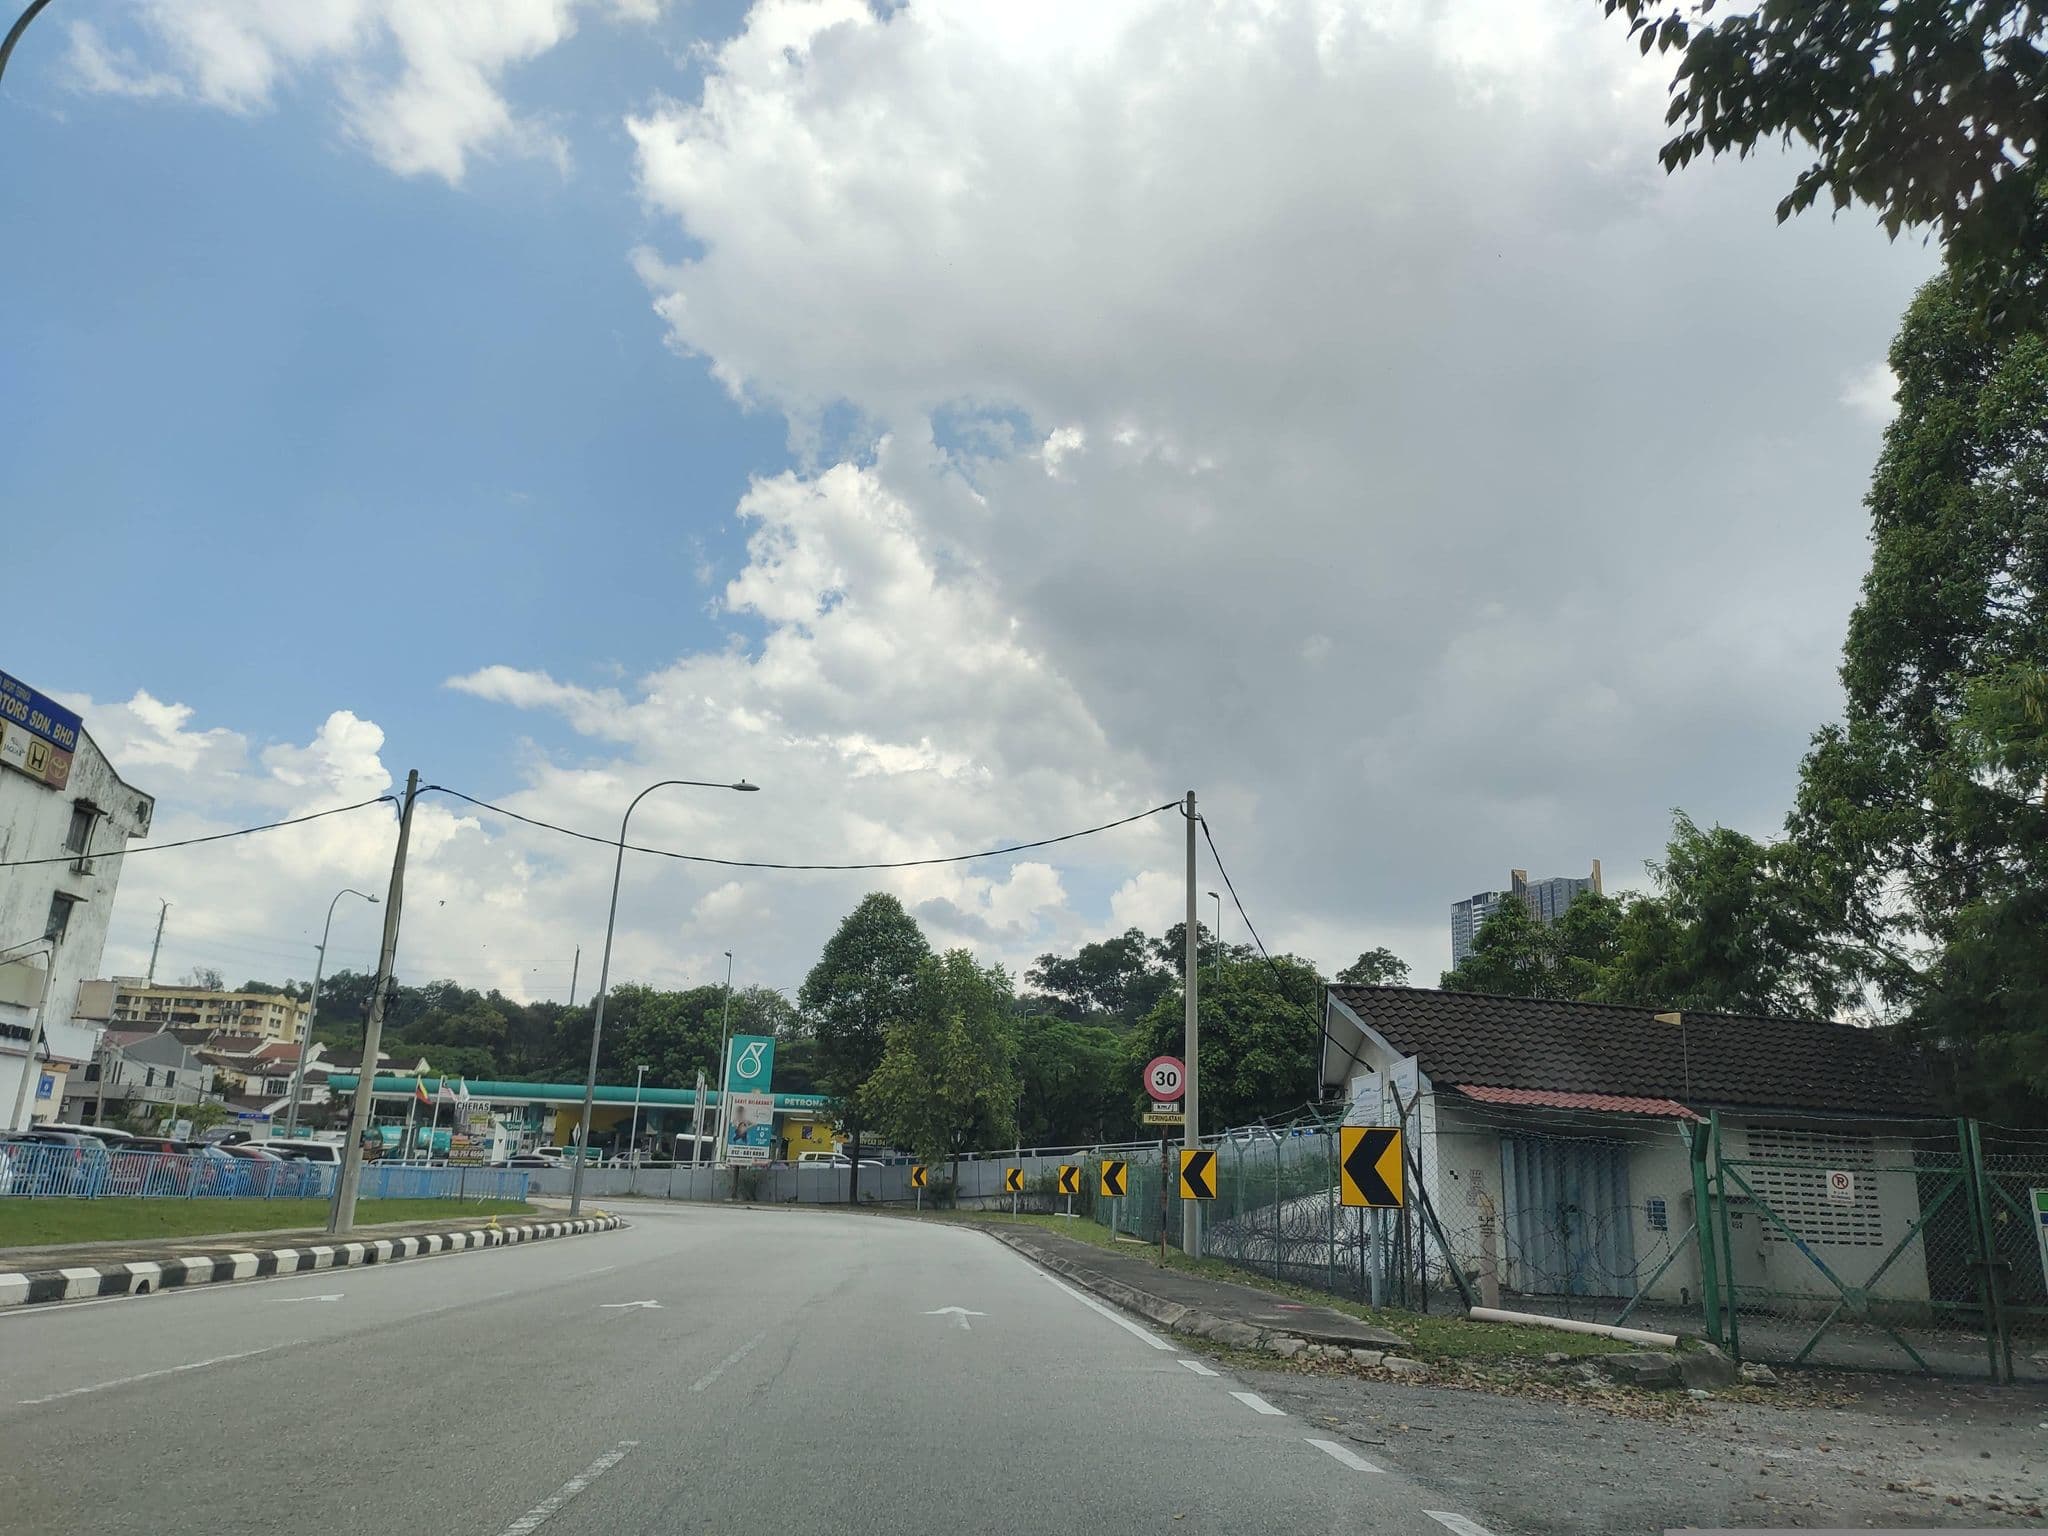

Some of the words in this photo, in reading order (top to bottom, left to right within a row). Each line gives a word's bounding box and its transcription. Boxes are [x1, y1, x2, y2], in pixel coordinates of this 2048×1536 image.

[0, 688, 29, 723] TORS
[29, 709, 51, 735] SDN.
[53, 723, 75, 748] BHD.
[1155, 1071, 1177, 1086] 30
[456, 1101, 490, 1111] CHERAS
[1157, 1104, 1174, 1112] km/j
[1148, 1114, 1182, 1122] PERINGATAN
